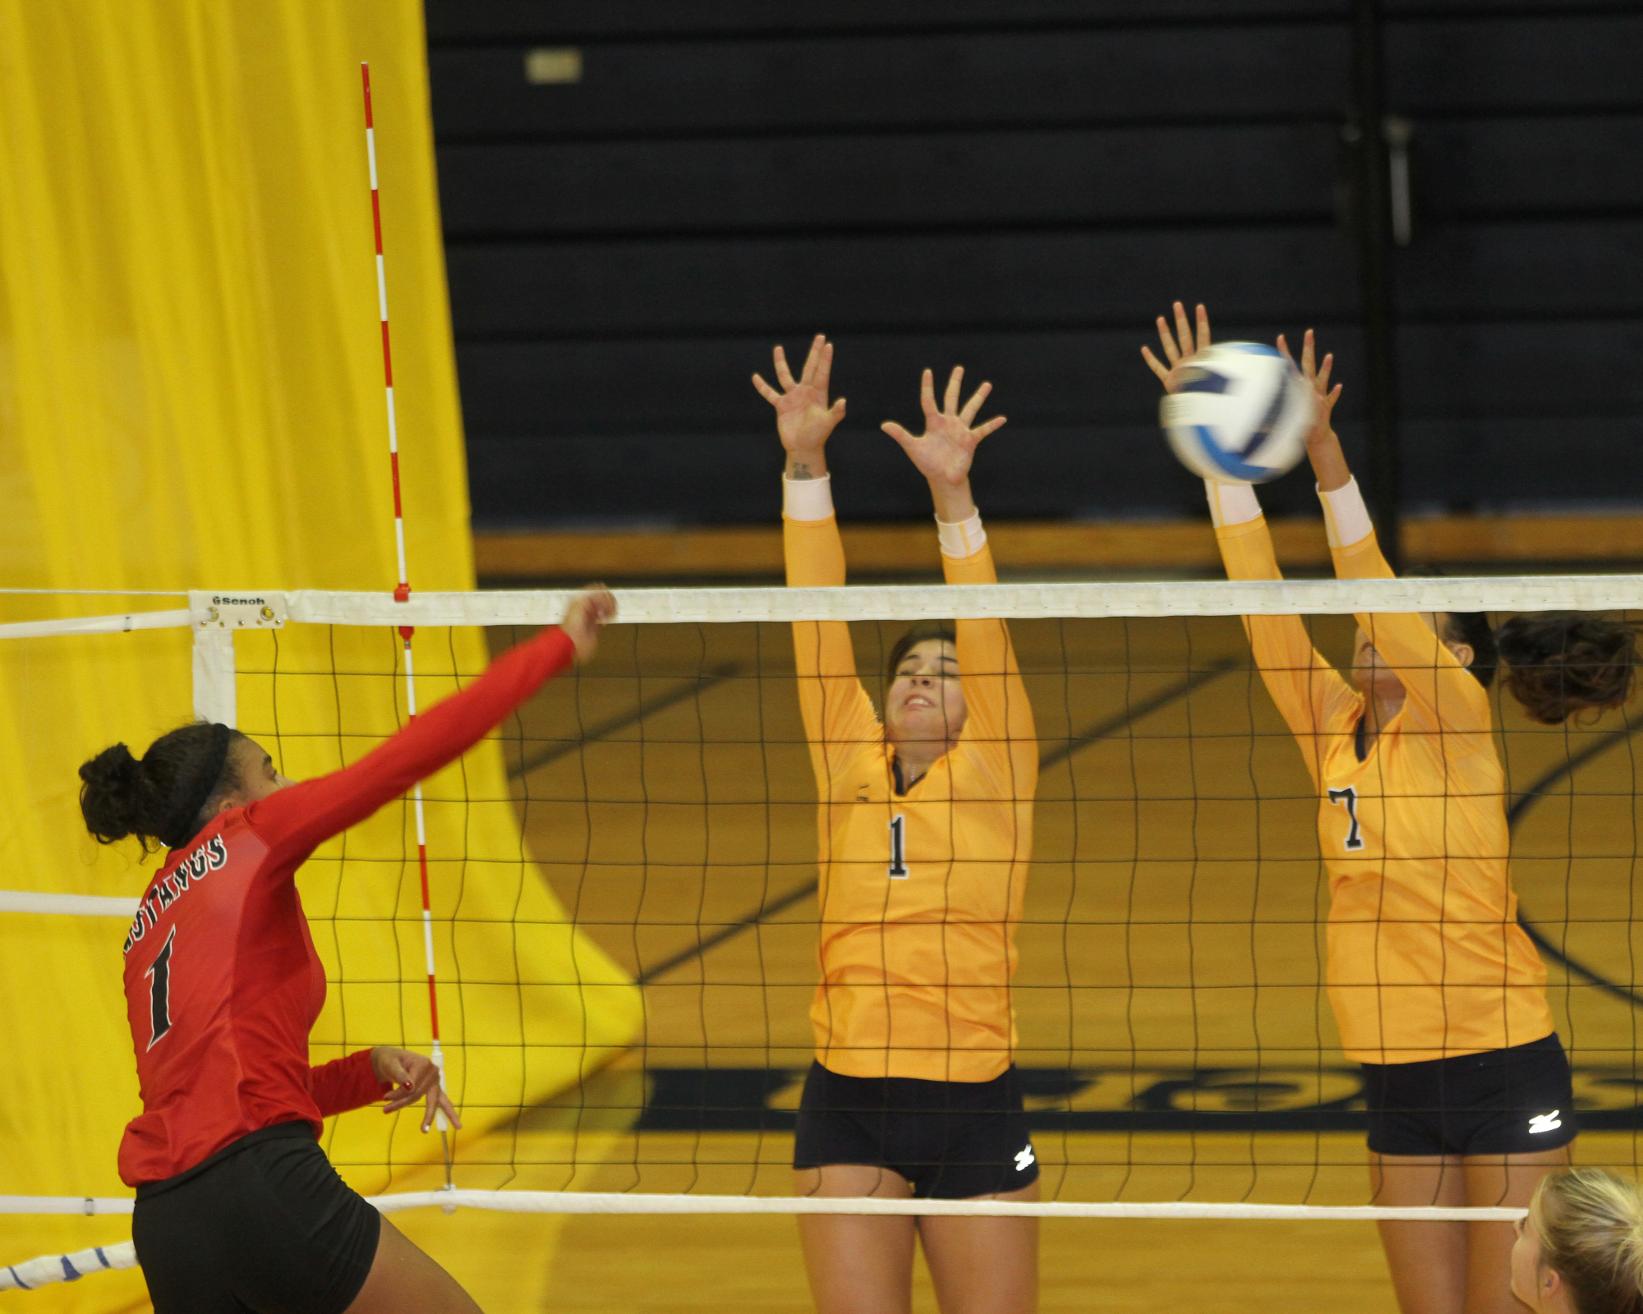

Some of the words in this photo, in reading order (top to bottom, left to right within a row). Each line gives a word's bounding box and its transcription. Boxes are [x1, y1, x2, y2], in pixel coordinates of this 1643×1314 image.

[888, 814, 909, 880] 1
[1327, 785, 1364, 852] 7
[144, 922, 177, 1053] 1
